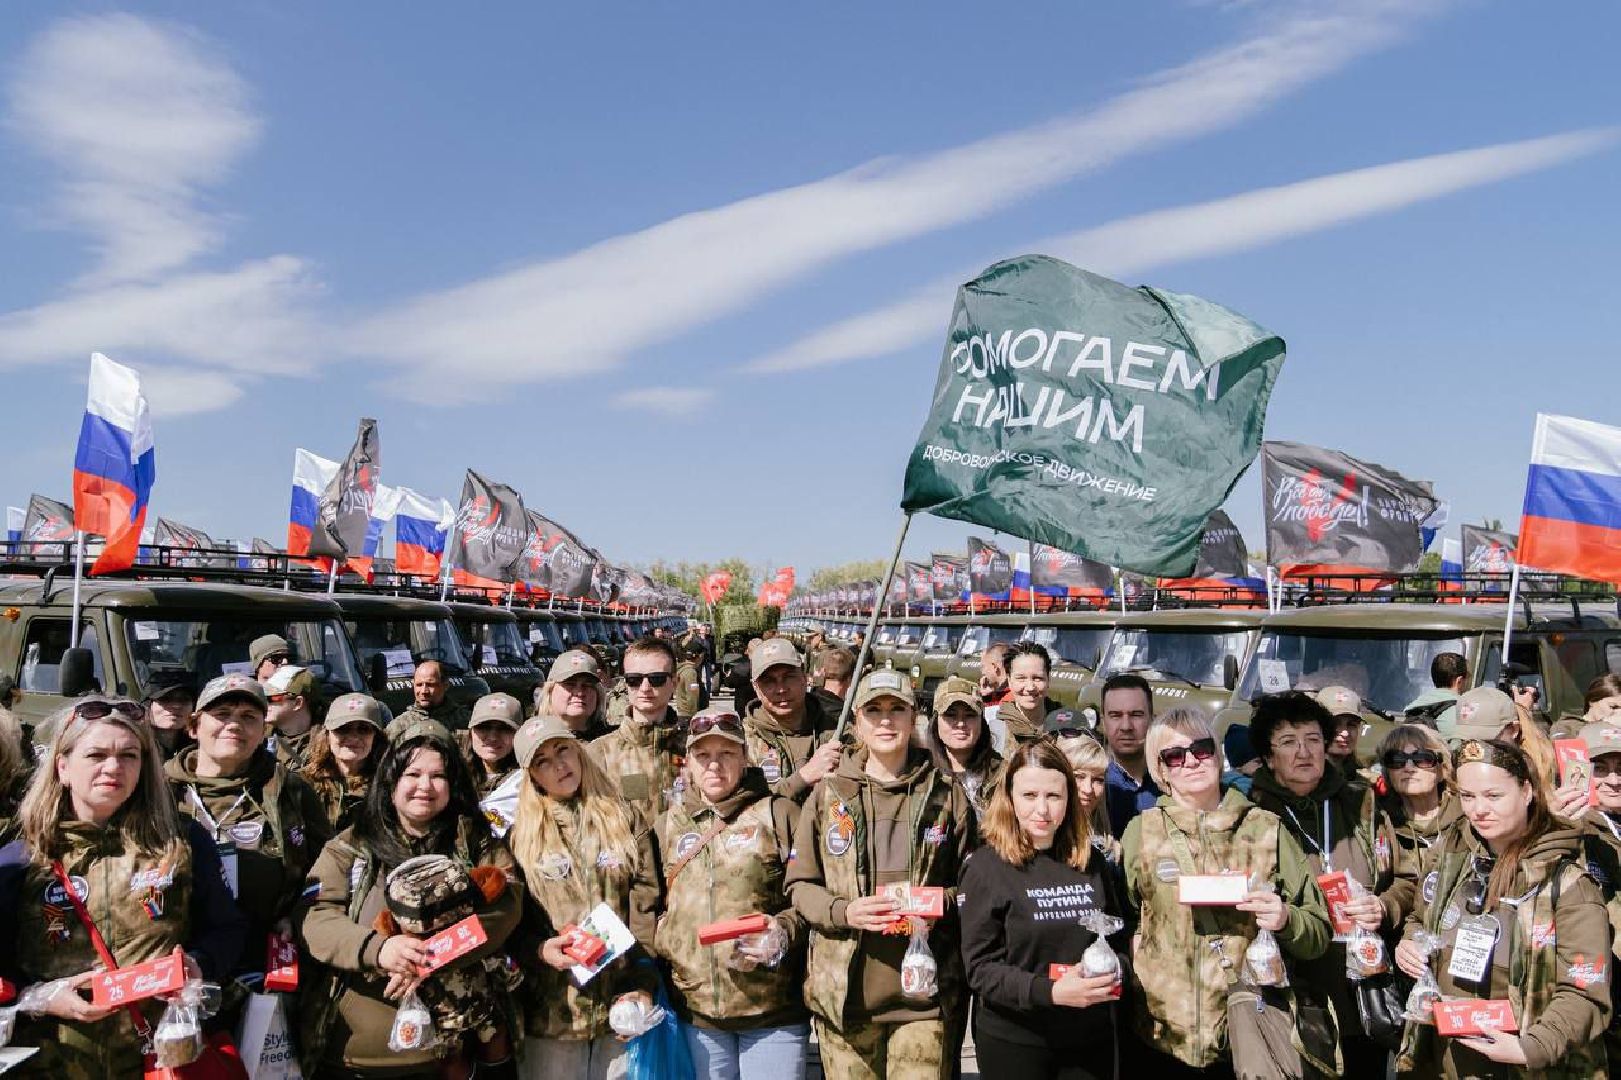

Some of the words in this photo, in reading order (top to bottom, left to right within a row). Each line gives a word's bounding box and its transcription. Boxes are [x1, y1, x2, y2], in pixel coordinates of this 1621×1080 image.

[951, 382, 1145, 453] НАШИМ
[1043, 458, 1157, 502] ДВИЖЕНИЕ
[1026, 883, 1095, 898] КОМАНДА
[1036, 895, 1093, 908] ПУТИНА
